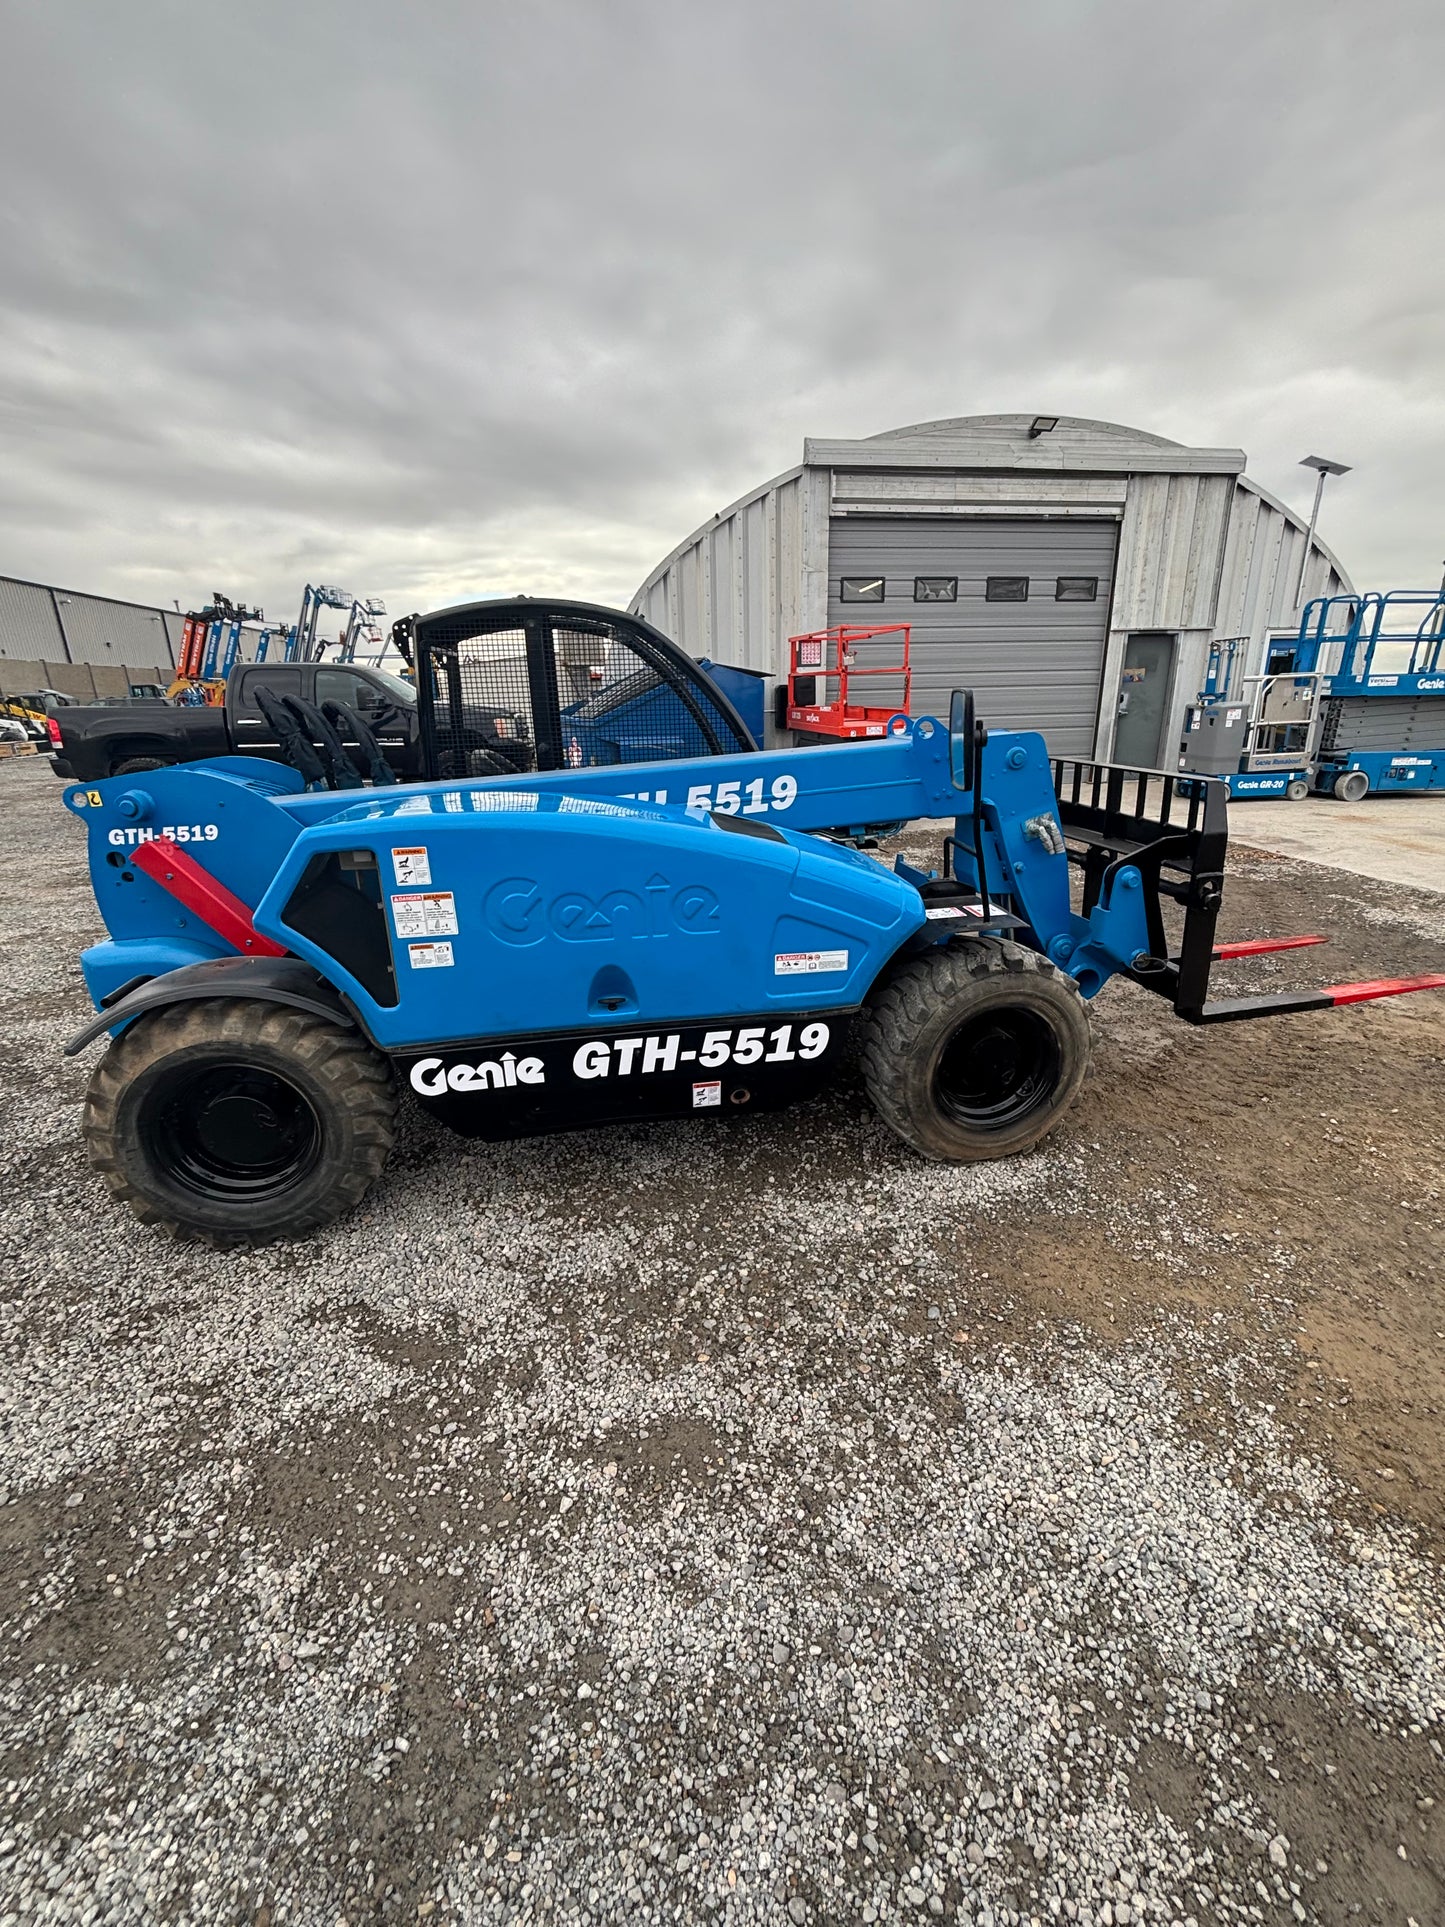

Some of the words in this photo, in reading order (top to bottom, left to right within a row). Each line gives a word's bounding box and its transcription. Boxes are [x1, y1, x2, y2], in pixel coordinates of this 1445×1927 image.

[1417, 678, 1445, 690] Genie
[1237, 780, 1259, 789] Genie
[1260, 780, 1285, 789] GR-20
[108, 824, 219, 846] GTH-5519
[482, 872, 721, 947] Genie
[409, 1051, 545, 1097] Genie
[572, 1022, 830, 1080] GTH-5519
